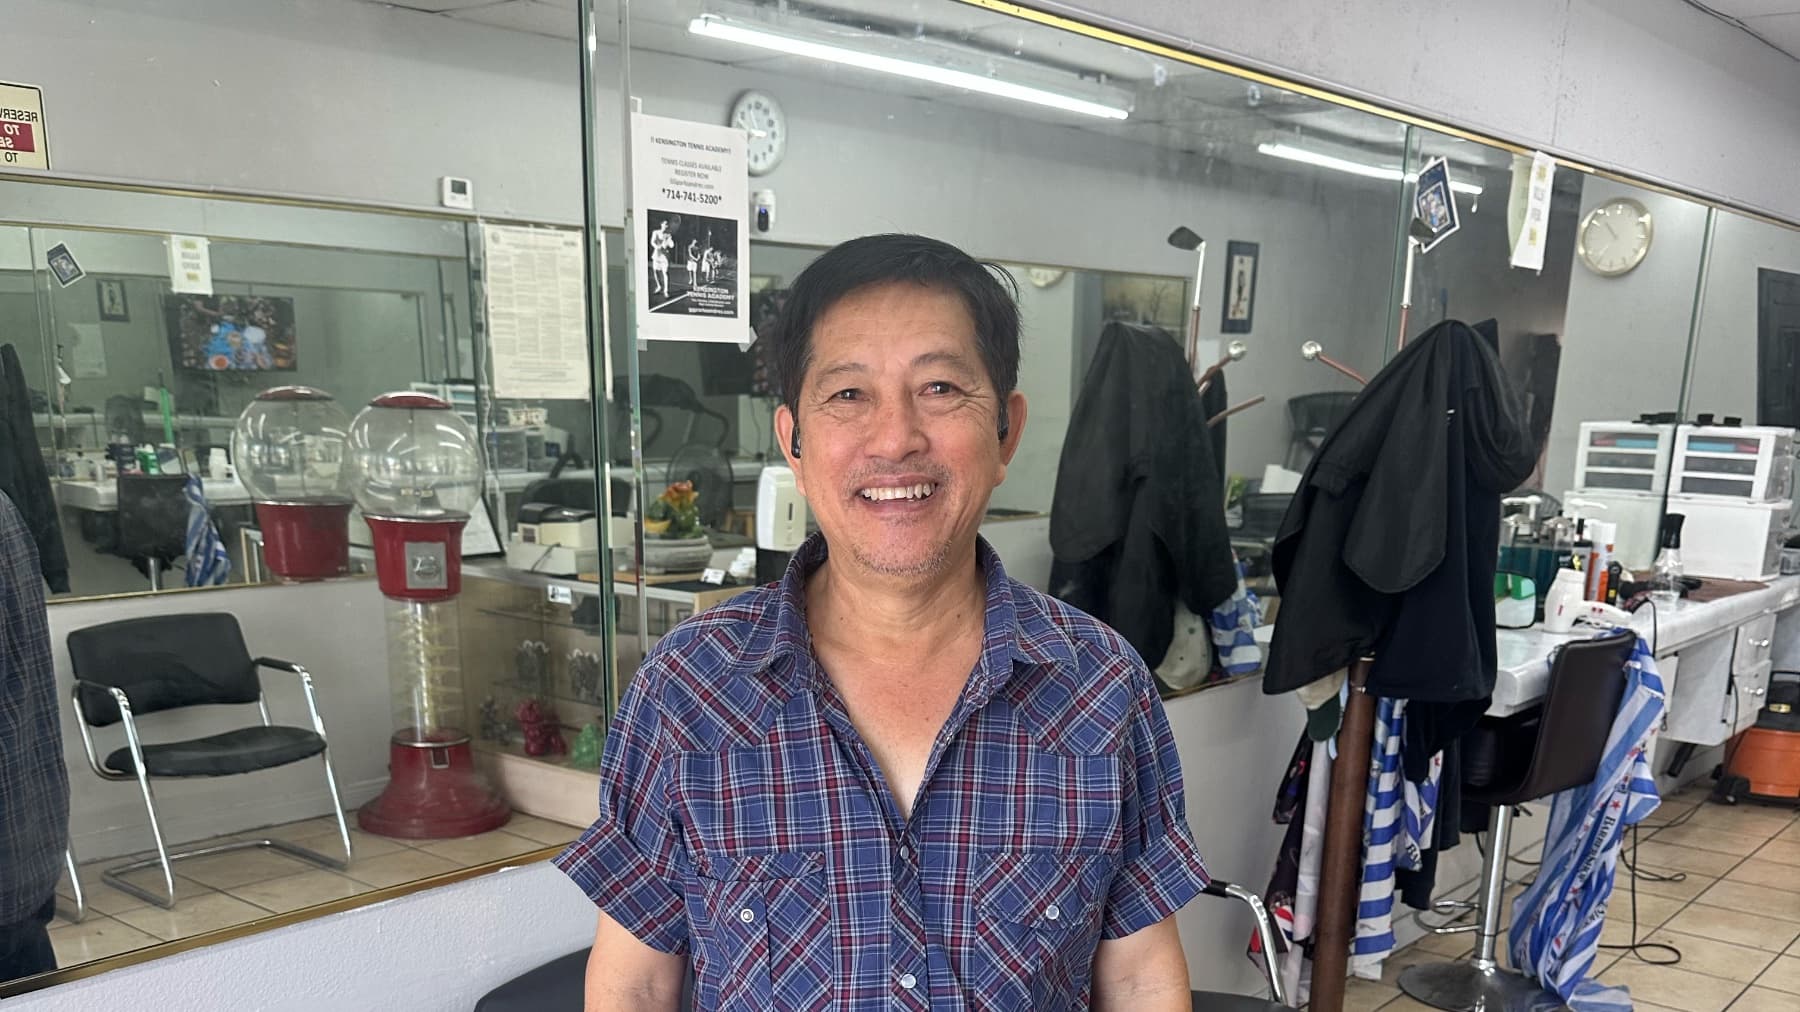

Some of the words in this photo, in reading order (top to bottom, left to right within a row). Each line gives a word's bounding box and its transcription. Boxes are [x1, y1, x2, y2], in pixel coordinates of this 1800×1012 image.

[655, 137, 687, 148] KENSINGTON
[687, 142, 704, 151] TENNIS
[661, 156, 679, 166] TENNIS
[678, 159, 697, 168] CLASSES
[698, 162, 722, 173] AVAILABLE
[674, 169, 696, 178] REGISTER
[707, 293, 735, 301] ACADEMY
